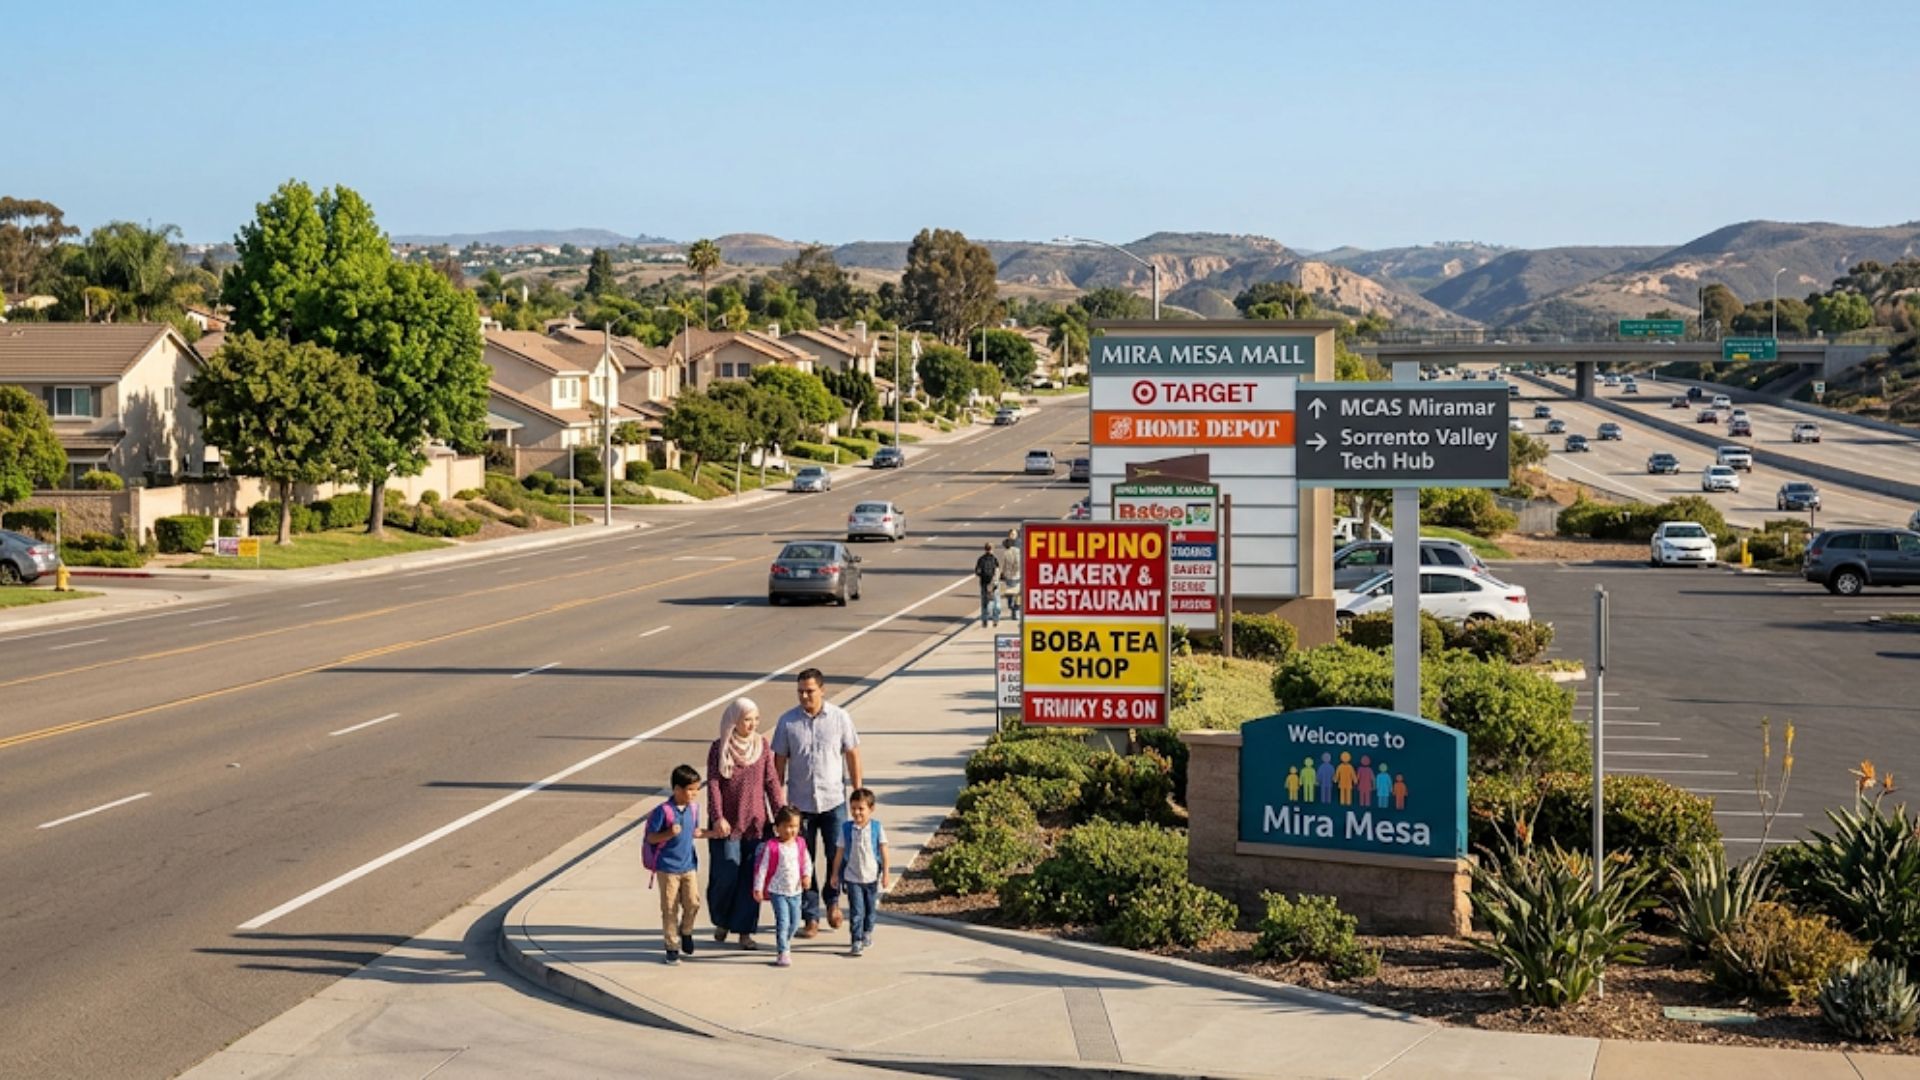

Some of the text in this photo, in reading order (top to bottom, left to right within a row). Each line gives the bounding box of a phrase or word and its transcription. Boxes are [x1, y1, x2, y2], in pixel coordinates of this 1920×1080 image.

[1101, 345, 1305, 364] MIRA MESA MALL
[1161, 383, 1258, 403] TARGET
[1340, 398, 1496, 417] MCAS Miramar
[1135, 419, 1280, 438] HOME DEPOT
[1340, 427, 1498, 450] Sorrento Valley
[1340, 451, 1435, 470] Tech Hub
[1029, 531, 1162, 559] FILIPINO
[1038, 563, 1152, 586] BAKERY &
[1029, 588, 1161, 611] RESTAURANT
[1031, 630, 1159, 653] BOBA TEA
[1060, 656, 1129, 679] SHOP
[1131, 699, 1157, 719] ON
[1288, 724, 1405, 749] Welcome to
[1262, 804, 1431, 846] Mira Mesa
